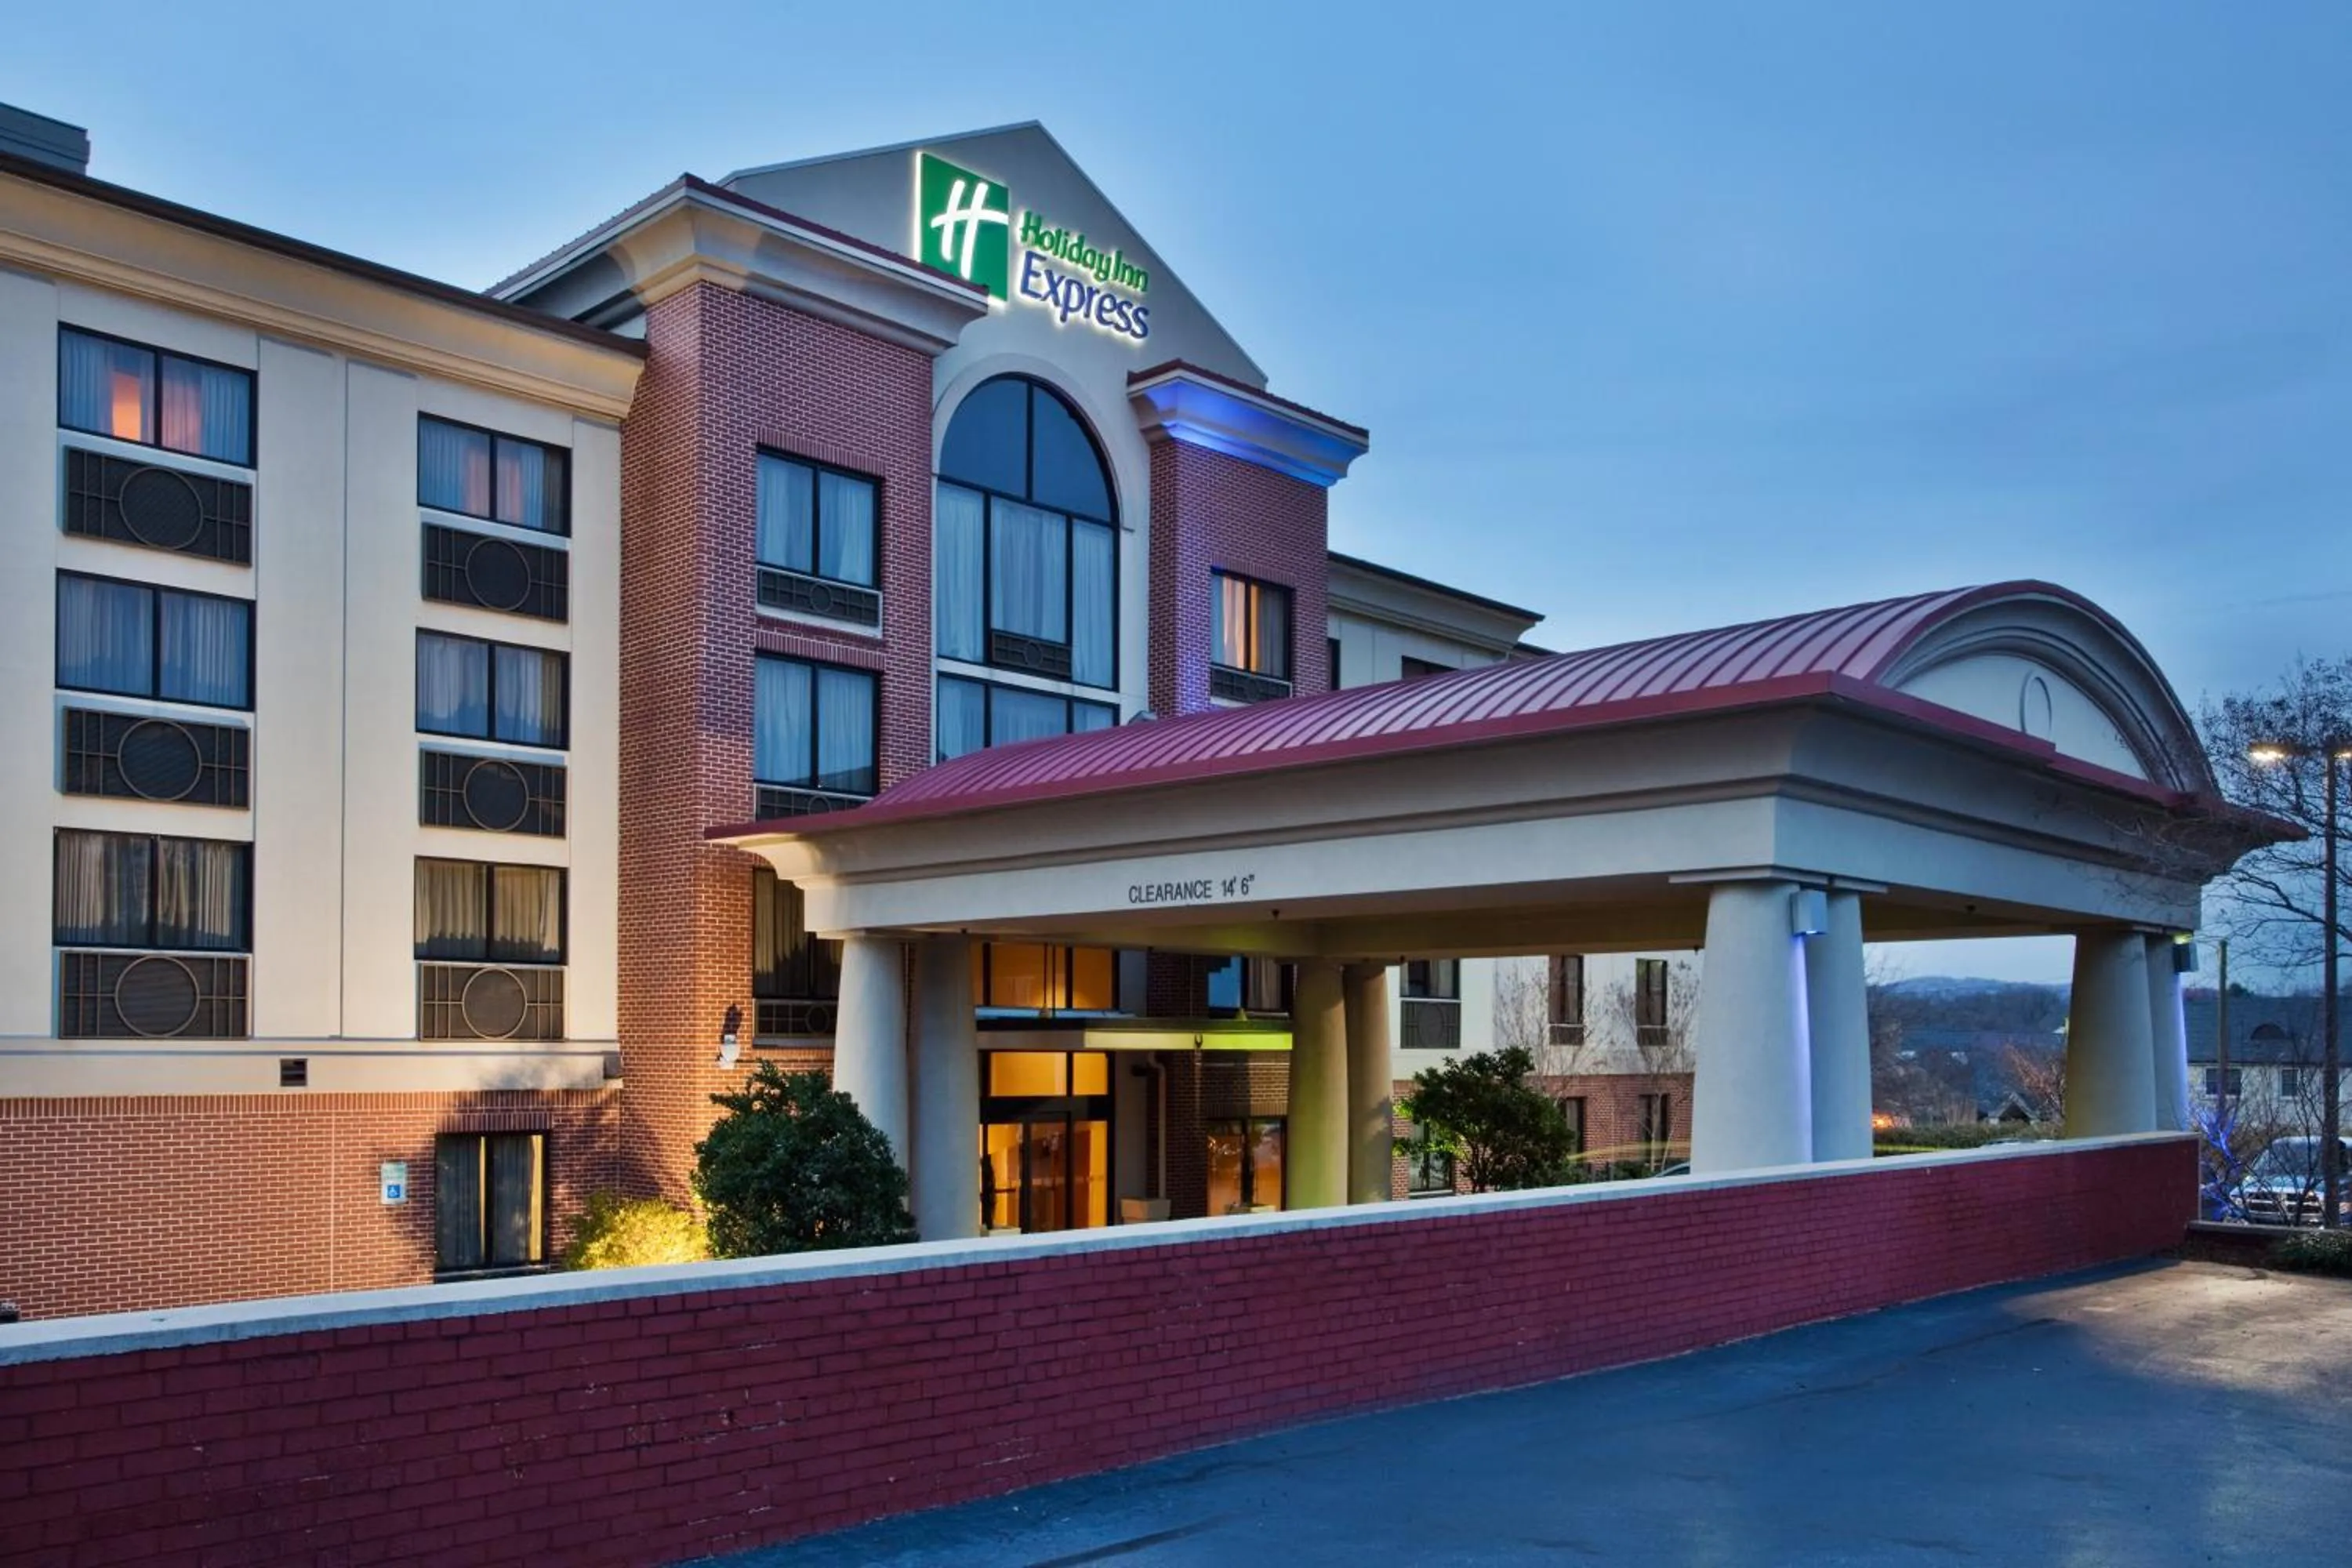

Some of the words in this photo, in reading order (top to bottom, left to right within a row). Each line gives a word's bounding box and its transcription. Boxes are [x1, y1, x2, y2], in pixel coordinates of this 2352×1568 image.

[1020, 210, 1112, 281] Holiday
[1114, 249, 1149, 292] Inn
[1020, 250, 1150, 339] Express
[1128, 880, 1212, 904] CLEARANCE
